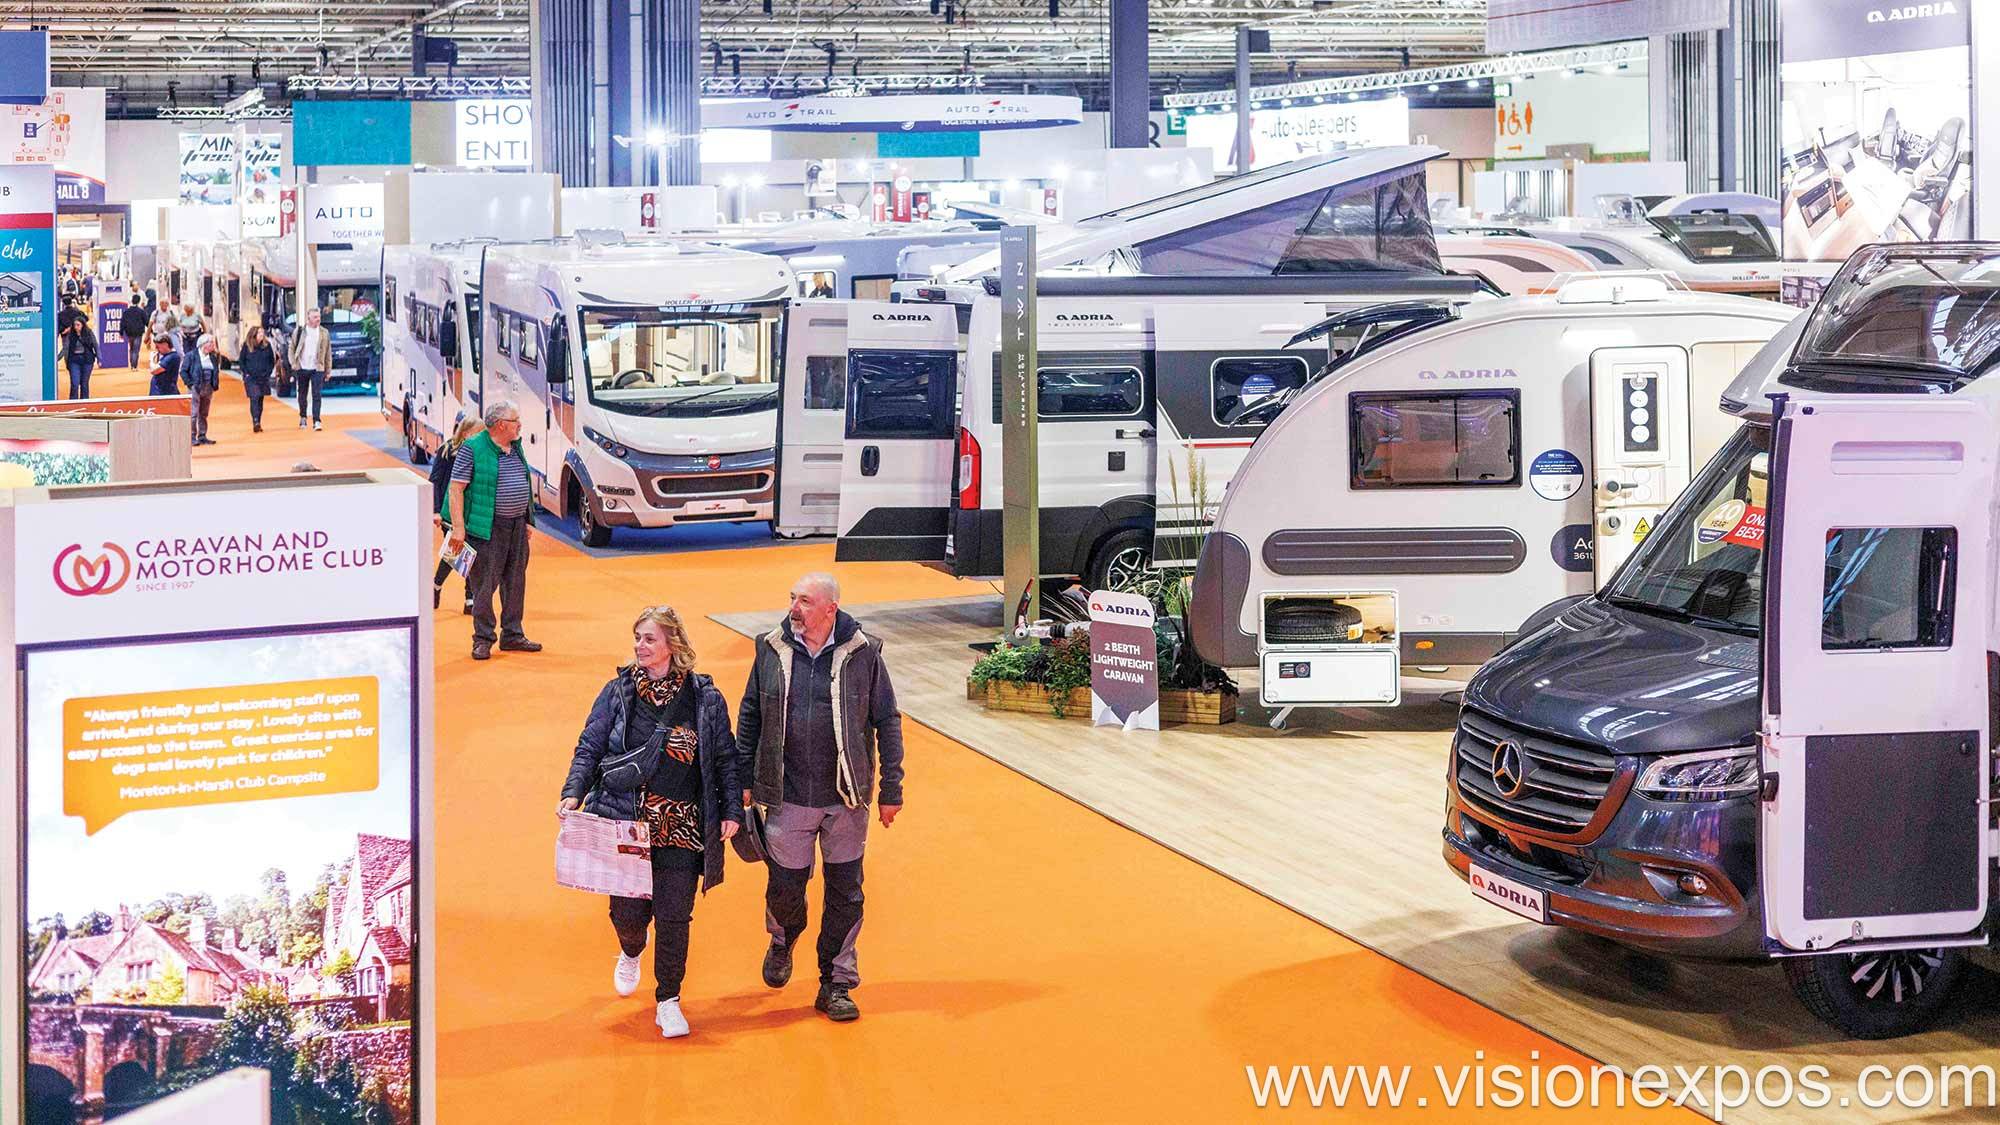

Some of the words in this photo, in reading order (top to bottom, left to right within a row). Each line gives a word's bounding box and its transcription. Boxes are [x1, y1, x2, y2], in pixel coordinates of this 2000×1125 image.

[1887, 1, 1957, 21] ADRIA
[465, 104, 532, 126] SHO
[746, 111, 776, 119] AUTO
[0, 186, 10, 196] B
[82, 184, 89, 199] 8
[315, 206, 373, 219] AUTO
[331, 229, 373, 239] TOGETHER
[1, 239, 33, 260] club
[104, 308, 122, 320] YOU
[104, 332, 124, 343] HER
[1443, 368, 1517, 379] ADRIA
[136, 533, 263, 558] CARAVAN
[272, 531, 328, 551] AND
[136, 552, 313, 580] MOTORHOME
[323, 548, 384, 569] CLUB
[136, 582, 167, 593] SINCE
[171, 581, 195, 591] 1907
[1105, 604, 1151, 618] ADRIA
[1104, 643, 1110, 651] 2
[1111, 642, 1141, 655] BERTH
[1093, 653, 1154, 671] LIGHTWEIGHT
[1103, 668, 1144, 684] CARAVAN
[141, 703, 193, 718] friendly
[194, 701, 220, 714] and
[221, 697, 292, 712] welcoming
[294, 693, 324, 707] staff
[327, 692, 360, 706] upon
[155, 722, 199, 736] during
[201, 720, 224, 731] our
[226, 717, 254, 731] stay
[263, 713, 306, 727] Lovely
[307, 711, 331, 723] site
[333, 708, 362, 721] with
[67, 749, 99, 761] easy
[100, 744, 145, 758] access
[146, 743, 162, 754] to
[163, 740, 187, 753] the
[189, 738, 226, 751] town.
[232, 734, 269, 747] Great
[270, 730, 323, 744] exercise
[324, 727, 353, 740] area
[355, 725, 375, 737] for
[112, 762, 145, 776] dogs
[147, 759, 173, 772] and
[175, 756, 215, 770] lovely
[217, 753, 247, 768] park
[248, 751, 269, 763] for
[120, 779, 234, 799] Moreton-in-Marsh
[236, 776, 265, 789] Club
[268, 771, 327, 786] Campsite
[1488, 881, 1540, 912] ADRIA
